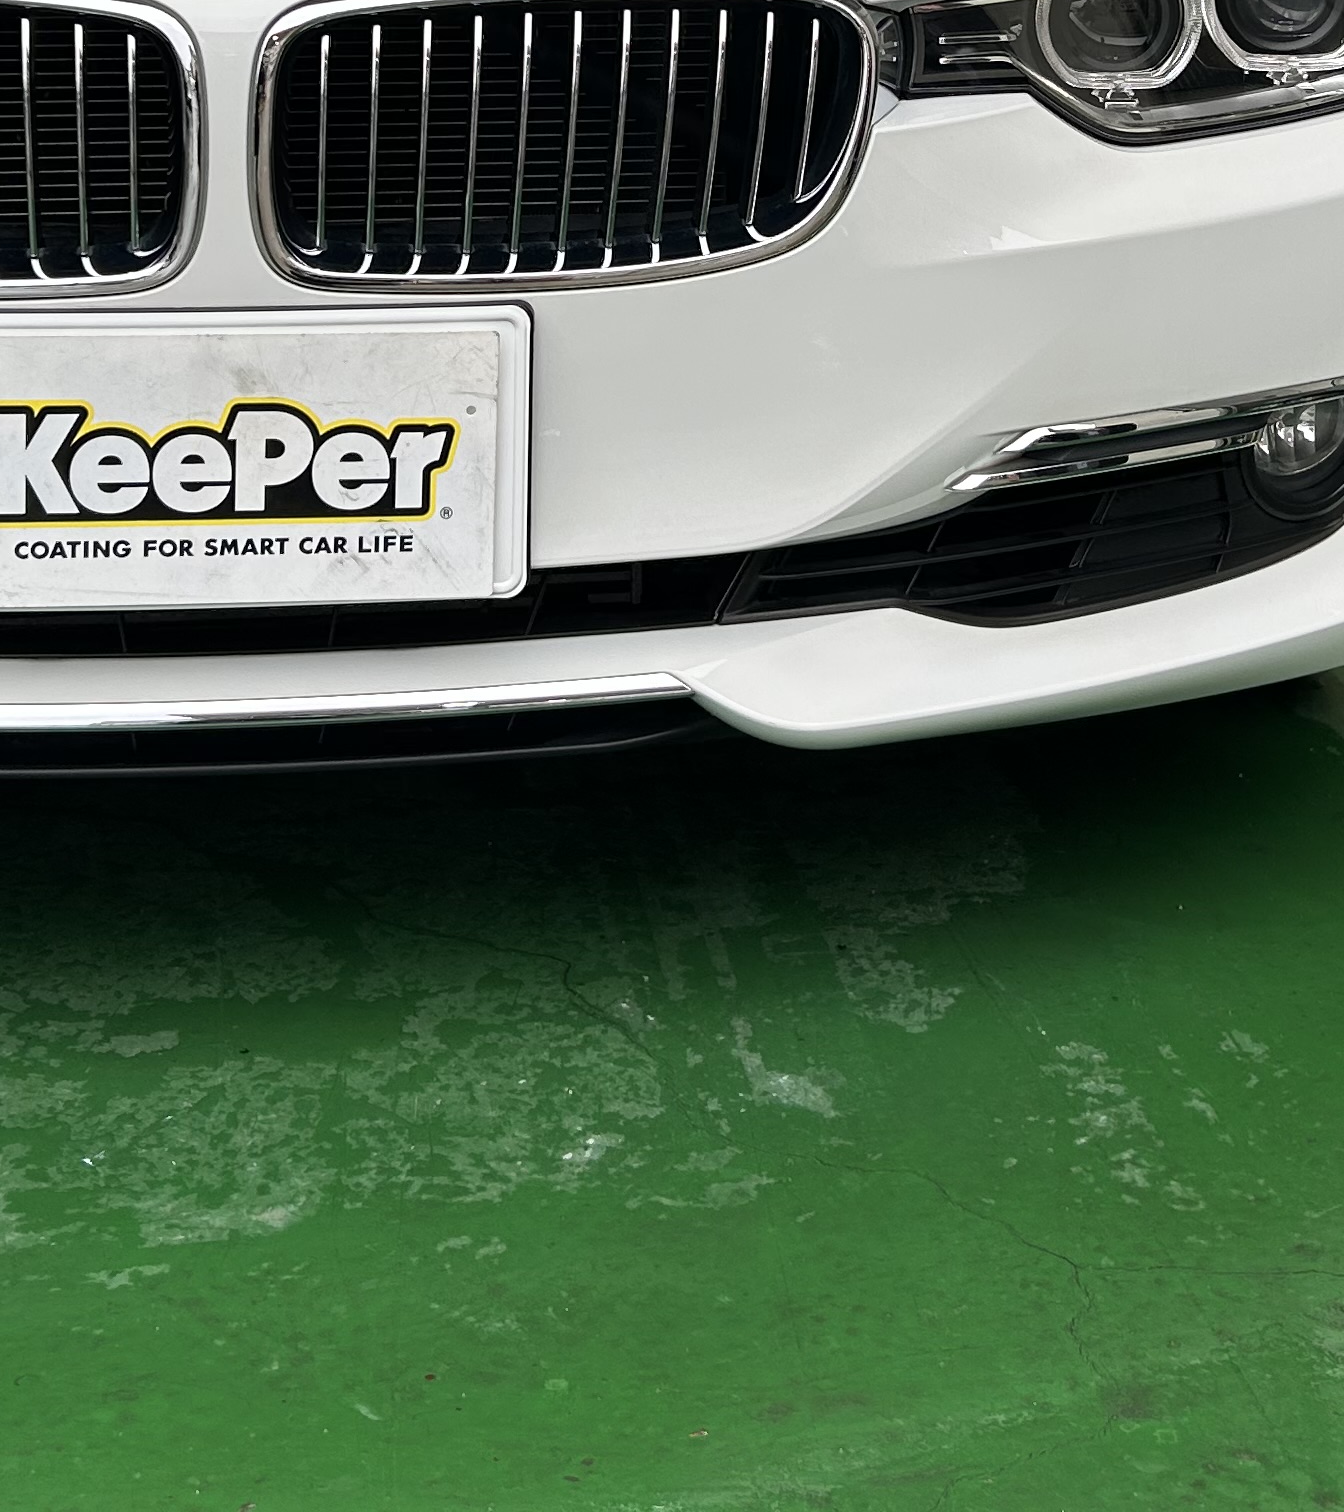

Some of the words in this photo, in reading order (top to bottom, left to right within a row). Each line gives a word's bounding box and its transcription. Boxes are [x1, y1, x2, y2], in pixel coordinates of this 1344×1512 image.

[14, 539, 132, 560] COATING
[143, 539, 194, 558] FOR
[204, 537, 290, 557] SMART
[298, 536, 348, 555] CAR
[358, 534, 414, 553] LIFE
